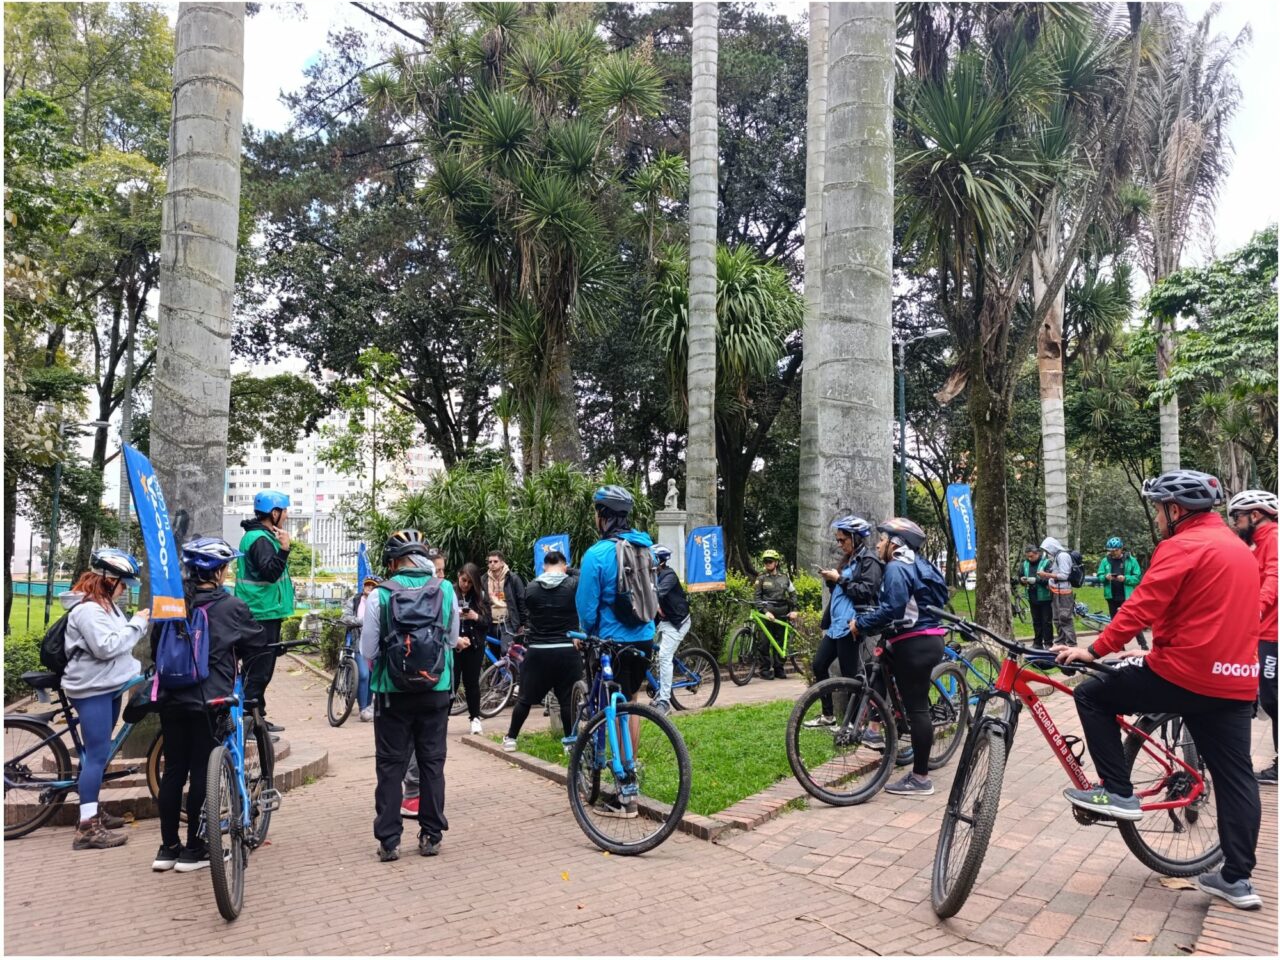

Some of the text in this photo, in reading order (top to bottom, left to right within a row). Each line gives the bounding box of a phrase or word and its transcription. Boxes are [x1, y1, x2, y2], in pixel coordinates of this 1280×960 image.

[1263, 655, 1277, 680] IDRD
[1033, 700, 1056, 736] Escuela
[1052, 733, 1063, 746] de
[1060, 745, 1069, 756] la
